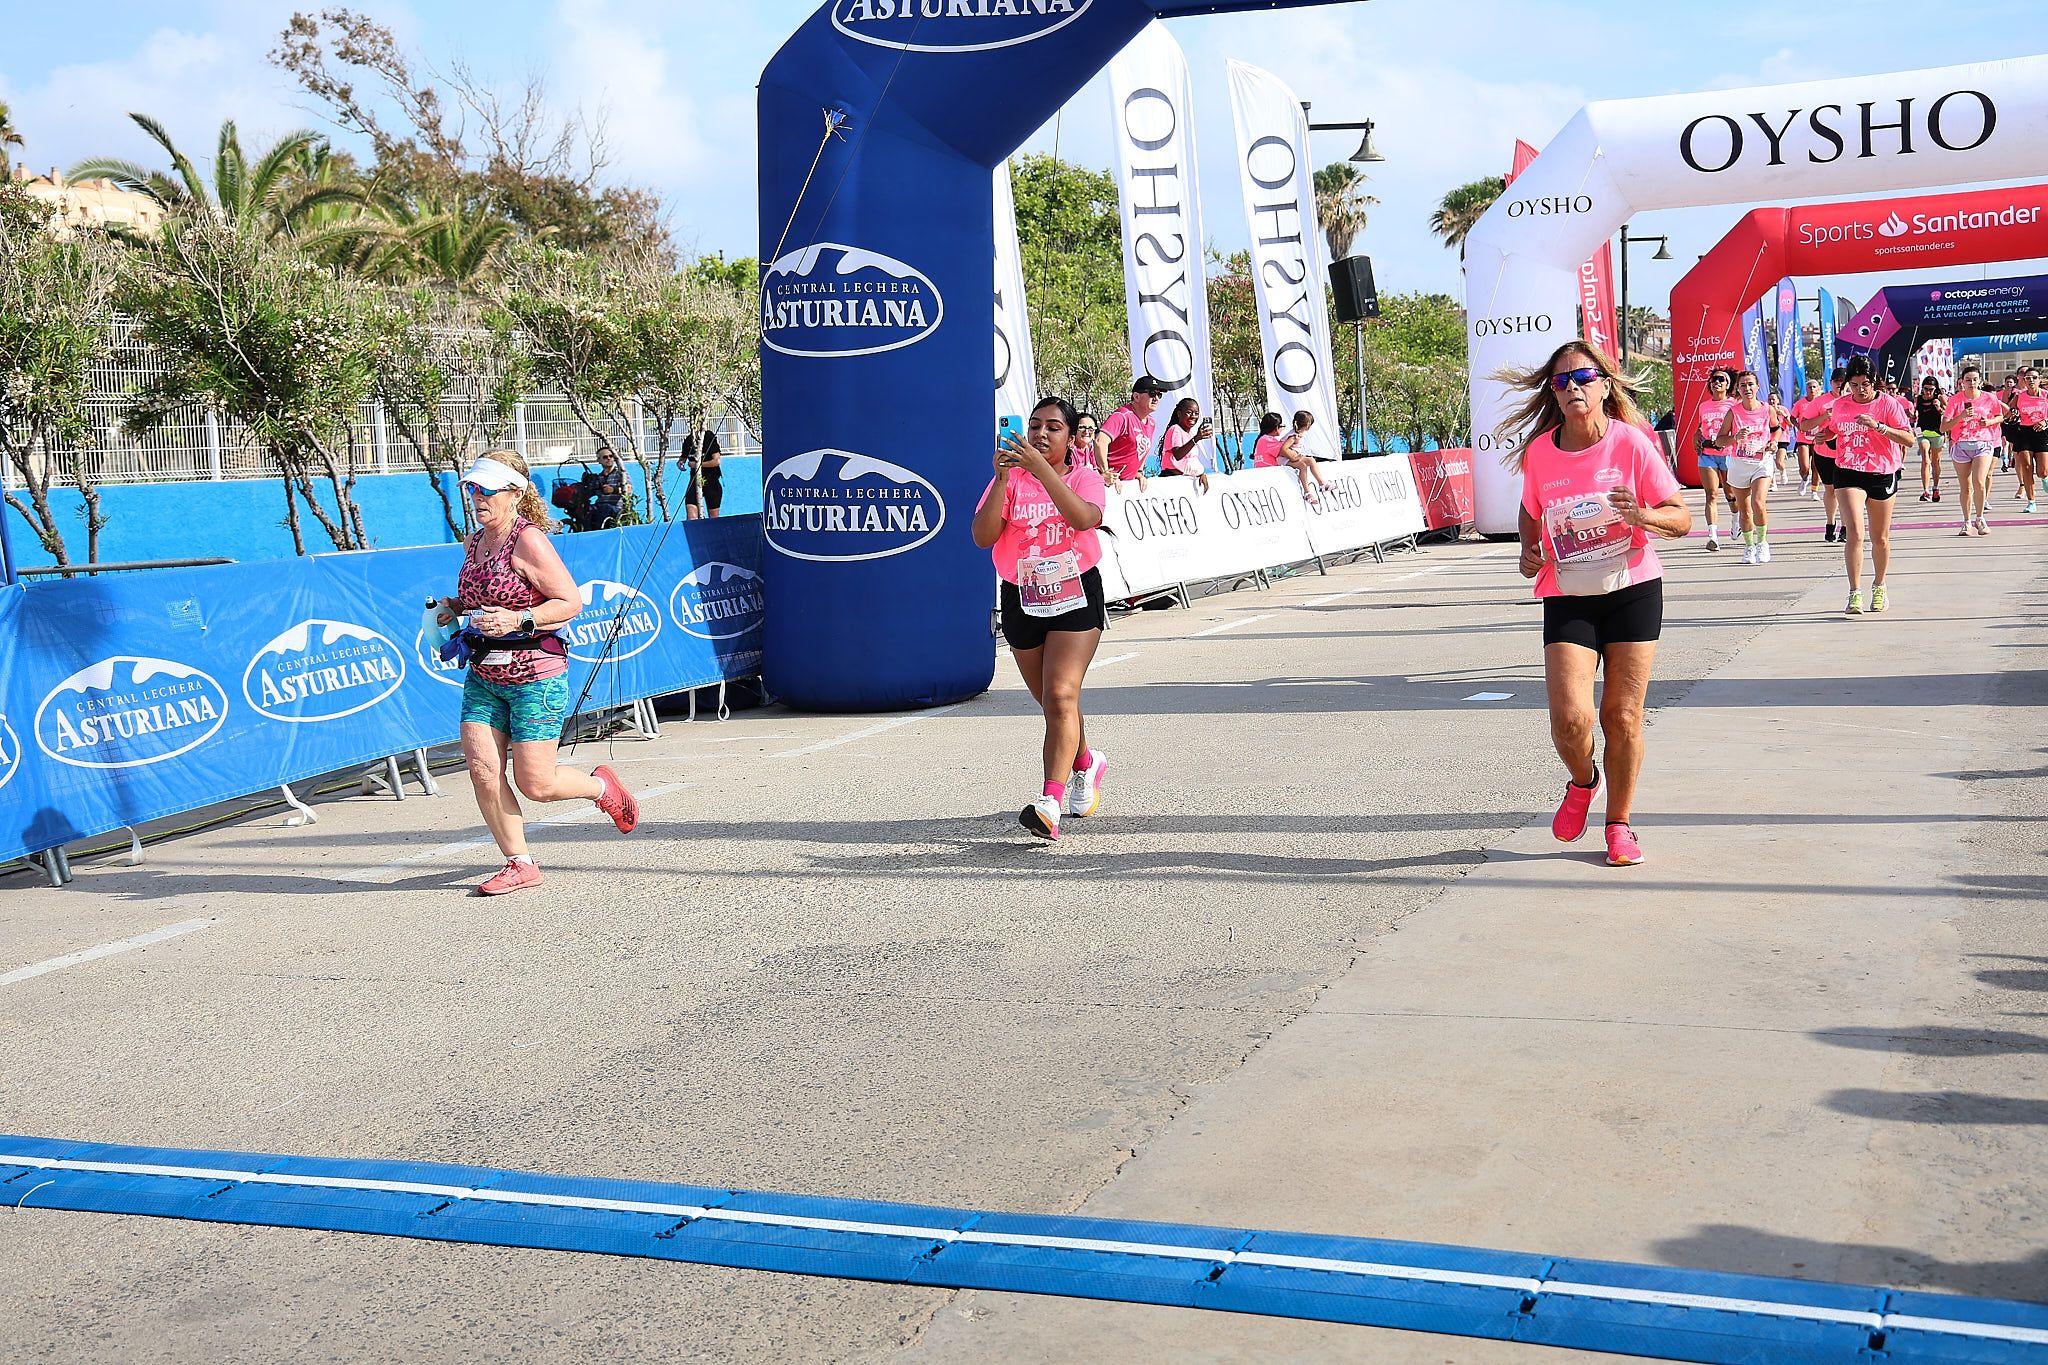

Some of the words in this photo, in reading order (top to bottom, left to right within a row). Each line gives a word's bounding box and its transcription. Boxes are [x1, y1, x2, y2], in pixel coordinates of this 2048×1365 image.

[1680, 90, 1997, 173] OYSHO
[1507, 195, 1593, 218] OYSHO
[1799, 220, 1874, 249] Sports
[1912, 205, 2041, 235] Santander
[1874, 241, 1955, 256] sportssantander.es
[778, 283, 836, 295] CENTRAL
[843, 282, 920, 294] LECHERA
[1944, 288, 1988, 299] octopus
[1988, 285, 2025, 297] energy
[763, 289, 928, 331] ASTURIANA
[1936, 302, 1971, 312] ENERGÍA
[1972, 302, 1994, 310] PARA
[1995, 299, 2029, 308] CORRER
[1943, 310, 1989, 318] VELOCIDAD
[1475, 314, 1552, 337] OYSHO
[1687, 335, 1721, 348] Sports
[1685, 350, 1736, 363] Santander
[781, 487, 838, 499] CENTRAL
[846, 488, 922, 499] LECHERA
[766, 489, 930, 532] ASTURIANA
[1124, 496, 1198, 541] OYSHO
[1221, 486, 1286, 530] OYSHO
[1577, 526, 1607, 541] 016
[691, 589, 725, 600] CENTRAL
[1039, 583, 1062, 595] 016
[277, 654, 329, 672] CENTRAL
[332, 643, 384, 660] LECHERA
[261, 656, 398, 708] ASTURIANA
[76, 693, 139, 713] CENTRAL
[143, 680, 203, 700] LECHERA
[56, 695, 218, 752] ASTURIANA
